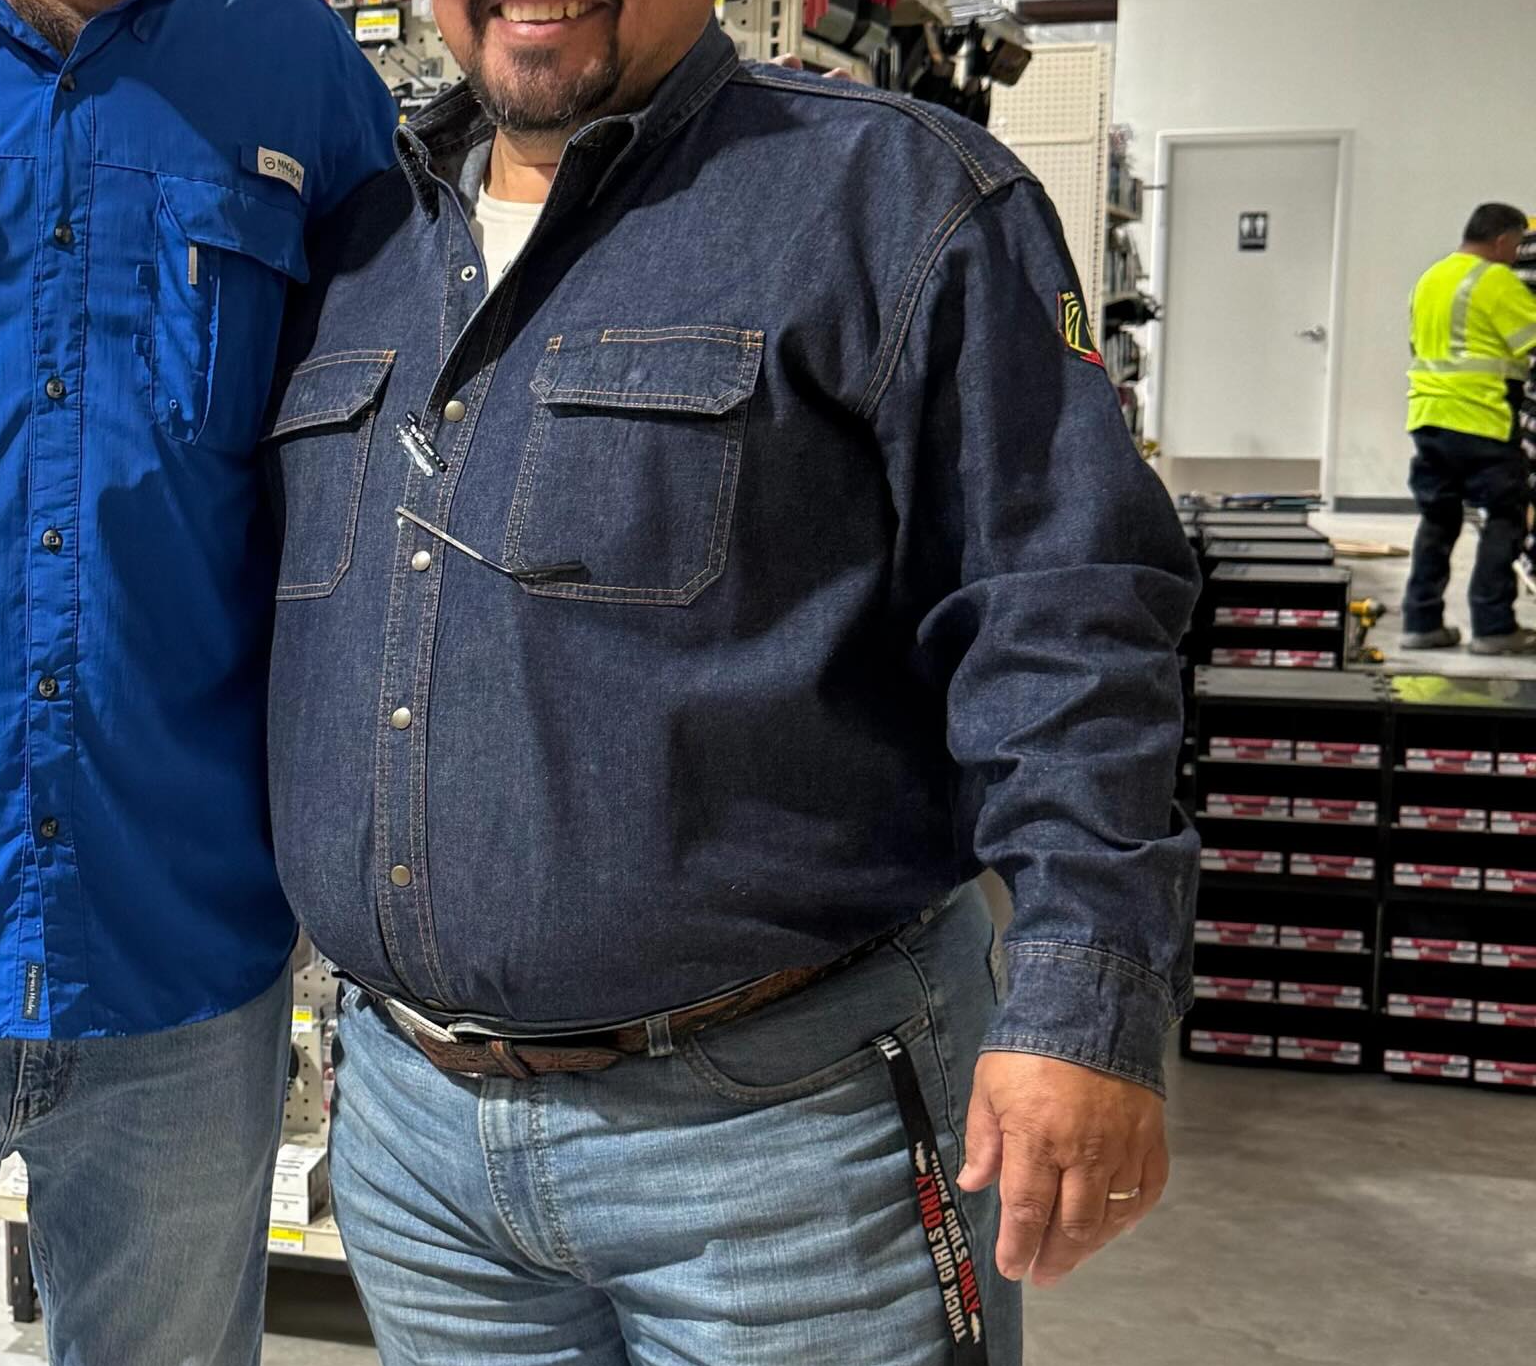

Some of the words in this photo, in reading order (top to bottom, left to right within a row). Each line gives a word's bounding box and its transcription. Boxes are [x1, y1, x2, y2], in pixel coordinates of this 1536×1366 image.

[916, 1172, 944, 1230] ONLY
[928, 1226, 957, 1284] GIRLS
[943, 1285, 967, 1344] THICK
[958, 1258, 982, 1315] ONLY
